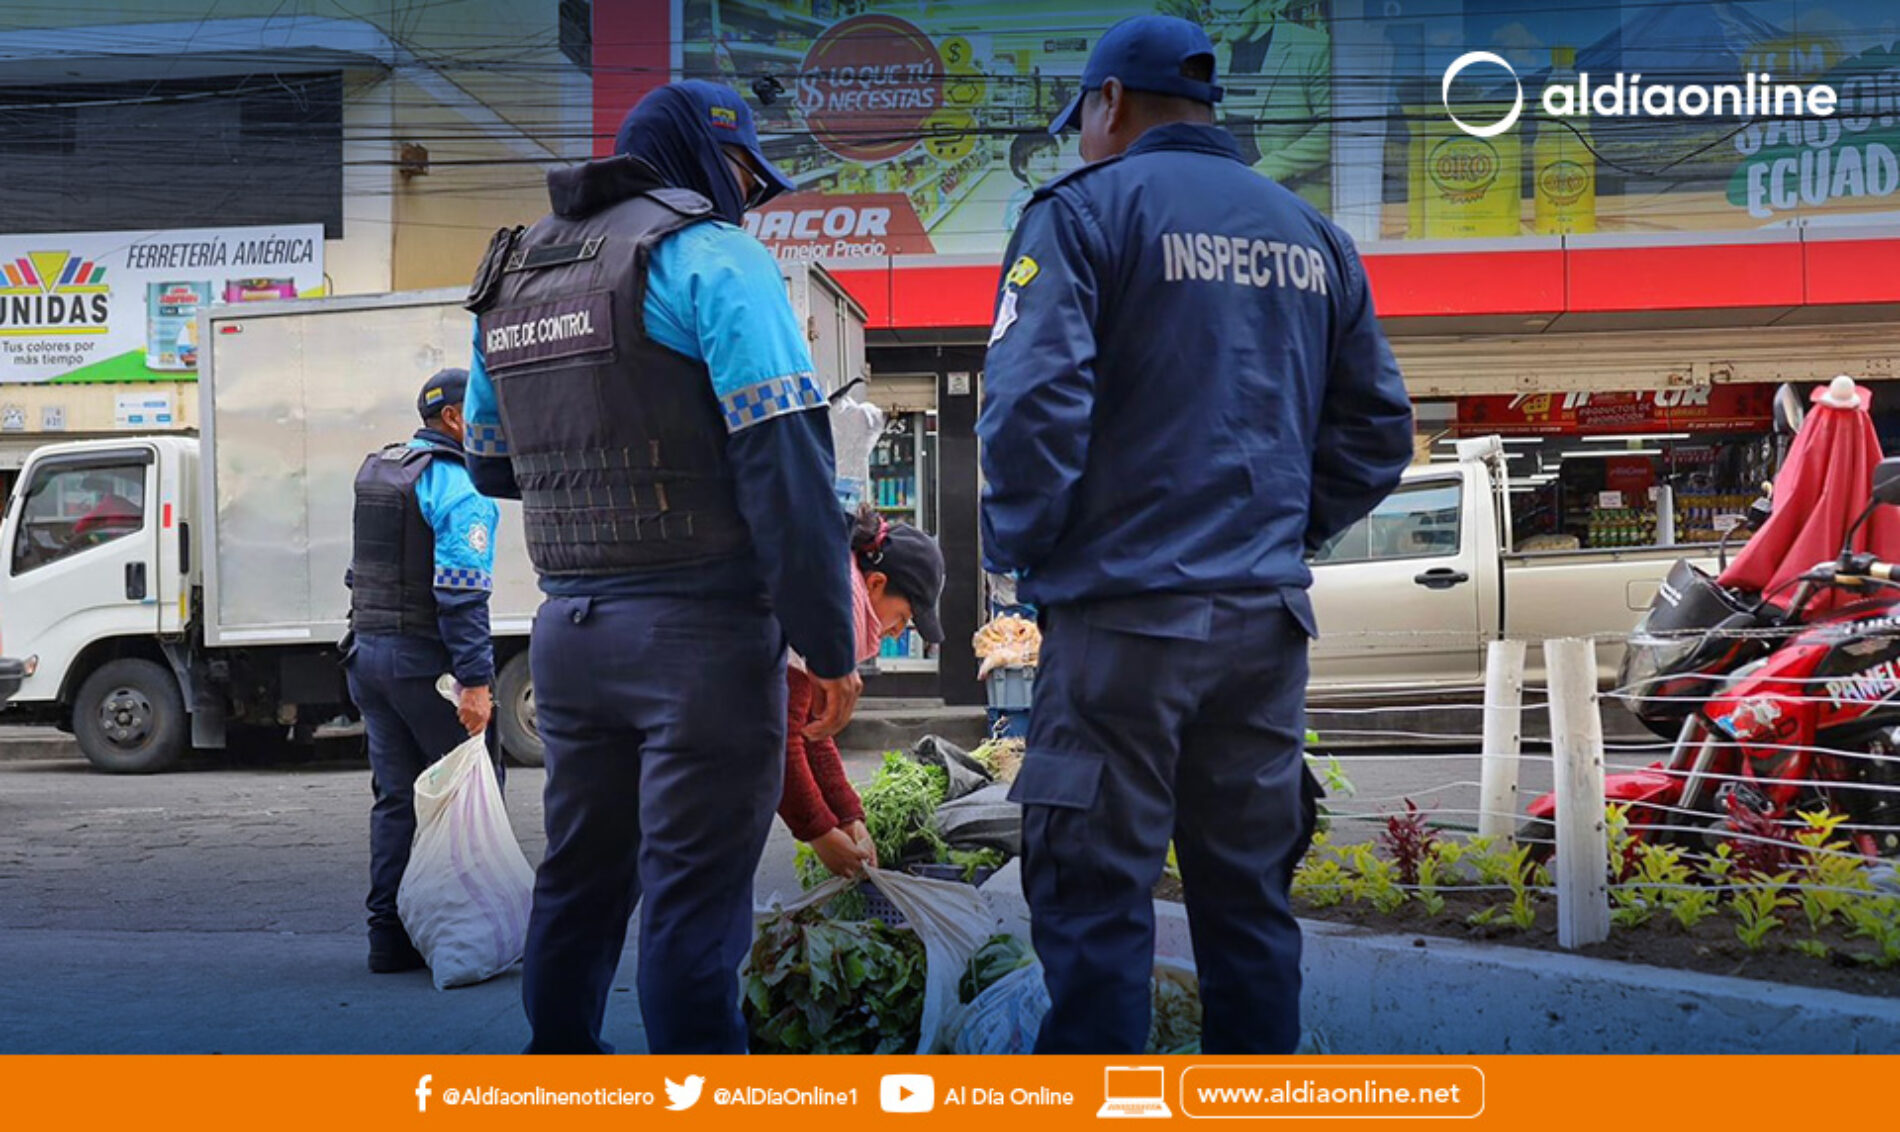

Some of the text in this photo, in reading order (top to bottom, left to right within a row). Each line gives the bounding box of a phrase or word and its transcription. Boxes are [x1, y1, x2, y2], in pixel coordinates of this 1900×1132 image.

[830, 58, 935, 89] LO QUE TÚ
[828, 87, 936, 111] NECESITAS
[1747, 143, 1899, 218] ECUAD
[126, 234, 314, 269] FERRETERÍA AMÉRICA
[782, 241, 833, 260] mejor
[834, 239, 886, 257] Precio
[1162, 232, 1328, 297] INSPECTOR
[521, 321, 537, 347] DE
[538, 310, 595, 343] CONTROL
[3, 341, 95, 354] Tus colores por
[14, 354, 84, 367] más tiempo
